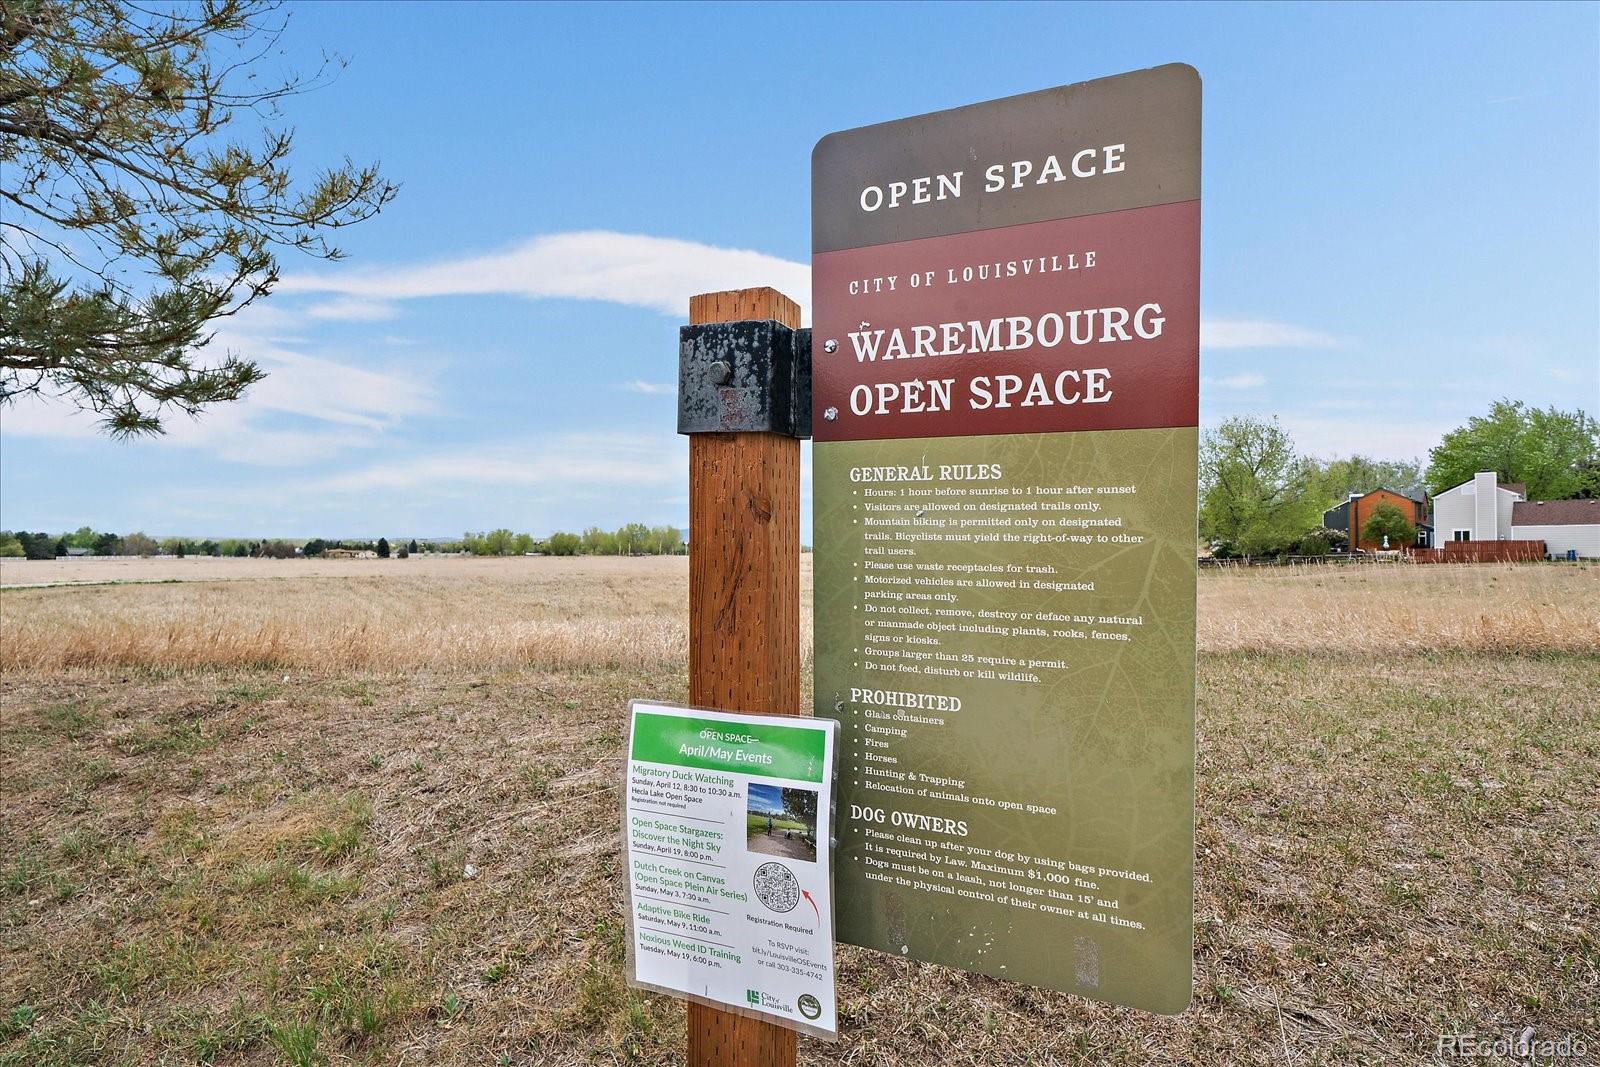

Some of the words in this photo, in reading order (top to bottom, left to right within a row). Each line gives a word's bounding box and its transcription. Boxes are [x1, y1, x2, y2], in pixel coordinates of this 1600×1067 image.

[860, 172, 963, 211] OPEN
[985, 144, 1124, 192] SPACE
[849, 275, 897, 294] CITY
[910, 271, 934, 287] OF
[947, 251, 1095, 283] LOUISVILLE
[847, 302, 1165, 363] WAREMBOURG
[850, 379, 955, 415] OPEN
[968, 368, 1112, 408] SPACE
[849, 465, 933, 482] GENERAL
[938, 464, 1001, 480] RULES
[864, 488, 896, 496] Hours:
[900, 488, 904, 496] 1
[908, 487, 932, 496] hour
[934, 487, 966, 495] before
[968, 486, 1008, 495] sunrise
[1011, 486, 1022, 495] to
[1026, 486, 1031, 494] 1
[1035, 486, 1063, 494] hour
[1065, 485, 1093, 494] after
[1096, 485, 1136, 494] sunset
[864, 546, 884, 554] trail
[864, 561, 894, 569] Please
[915, 562, 944, 570] waste
[946, 563, 1003, 573] receptacles
[1006, 563, 1022, 572] for
[1025, 564, 1057, 573] trash.
[864, 575, 911, 584] Motorized
[914, 577, 954, 586] vehicles
[975, 578, 1016, 588] allowed
[1019, 579, 1030, 588] in
[1033, 580, 1094, 591] designated
[864, 590, 903, 600] parking
[934, 592, 958, 603] only.
[864, 633, 890, 643] signs
[906, 635, 940, 645] kiosks.
[850, 688, 961, 711] PROHIBITED
[699, 730, 723, 740] OPEN
[864, 723, 907, 737] Camping
[678, 743, 733, 761] April/May
[735, 749, 772, 764] Events
[864, 738, 888, 748] Fires
[864, 752, 897, 763] Horses
[631, 776, 654, 787] Sunday,
[655, 780, 671, 789] April
[683, 783, 698, 792] 8:30
[698, 786, 706, 794] to
[708, 787, 727, 796] 10:30
[632, 765, 670, 779] Migratory
[672, 770, 692, 781] Duck
[694, 773, 733, 788] Watching
[864, 766, 905, 780] Hunting
[907, 771, 916, 780] &
[918, 773, 965, 788] Trapping
[649, 789, 664, 798] Lake
[665, 791, 682, 800] Open
[683, 794, 702, 803] Space
[865, 780, 914, 794] Relocation
[916, 788, 927, 796] of
[929, 791, 969, 802] animals
[971, 797, 995, 806] onto
[997, 800, 1023, 810] open
[1026, 804, 1056, 814] space
[631, 817, 652, 828] Open
[654, 820, 677, 832] Space
[679, 825, 723, 839] Stargazers:
[850, 804, 885, 823] DOG
[890, 811, 967, 836] OWNERS
[632, 830, 665, 842] Discover
[666, 835, 680, 845] the
[682, 838, 704, 849] Night
[706, 841, 721, 853] Sky
[632, 840, 655, 851] Sunday,
[656, 845, 671, 854] April
[672, 848, 682, 856] 19,
[683, 849, 698, 858] 8:00
[865, 828, 894, 840] Please
[896, 834, 921, 845] clean
[924, 839, 937, 849] up
[940, 841, 964, 851] after
[966, 846, 991, 856] your
[994, 849, 1014, 861] dog
[1016, 852, 1030, 864] by
[1033, 857, 1065, 869] using
[1068, 860, 1095, 873] bags
[1098, 867, 1152, 882] provided.
[633, 860, 657, 872] Dutch
[658, 865, 682, 876] Creek
[683, 871, 694, 879] on
[695, 871, 725, 885] Canvas
[864, 842, 872, 851] It
[874, 844, 883, 853] is
[885, 847, 927, 860] required
[929, 852, 941, 864] by
[944, 855, 967, 867] Law.
[970, 860, 1024, 876] Maximum
[1027, 869, 1069, 884] $1,000
[1074, 877, 1099, 890] fine.
[634, 872, 657, 883] (Open
[659, 876, 682, 888] Space
[684, 881, 704, 892] Plein
[706, 885, 718, 895] Air
[719, 888, 747, 902] Series)
[635, 883, 658, 894] Sunday,
[659, 887, 673, 897] May
[674, 890, 680, 898] 3,
[681, 891, 696, 901] 7:30
[697, 896, 710, 904] a.m.
[637, 902, 671, 916] Adaptive
[673, 909, 690, 920] Bike
[692, 912, 710, 924] Ride
[637, 912, 665, 925] Saturday,
[666, 918, 680, 928] May
[681, 921, 688, 930] 9,
[689, 923, 707, 933] 11:00
[746, 914, 783, 928] Registration
[784, 922, 813, 935] Required
[639, 932, 670, 946] Noxious
[672, 938, 695, 951] Weed
[697, 944, 706, 954] ID
[708, 947, 741, 964] Training
[639, 943, 665, 955] Tuesday,
[666, 948, 680, 959] May
[682, 952, 691, 962] 19,
[692, 955, 707, 964] 6:00
[707, 960, 721, 968] p.m.
[767, 939, 775, 947] To
[776, 941, 793, 951] RSVP
[776, 963, 822, 980] 303-335-4742
[761, 992, 777, 1002] City
[761, 999, 794, 1013] Louisville
